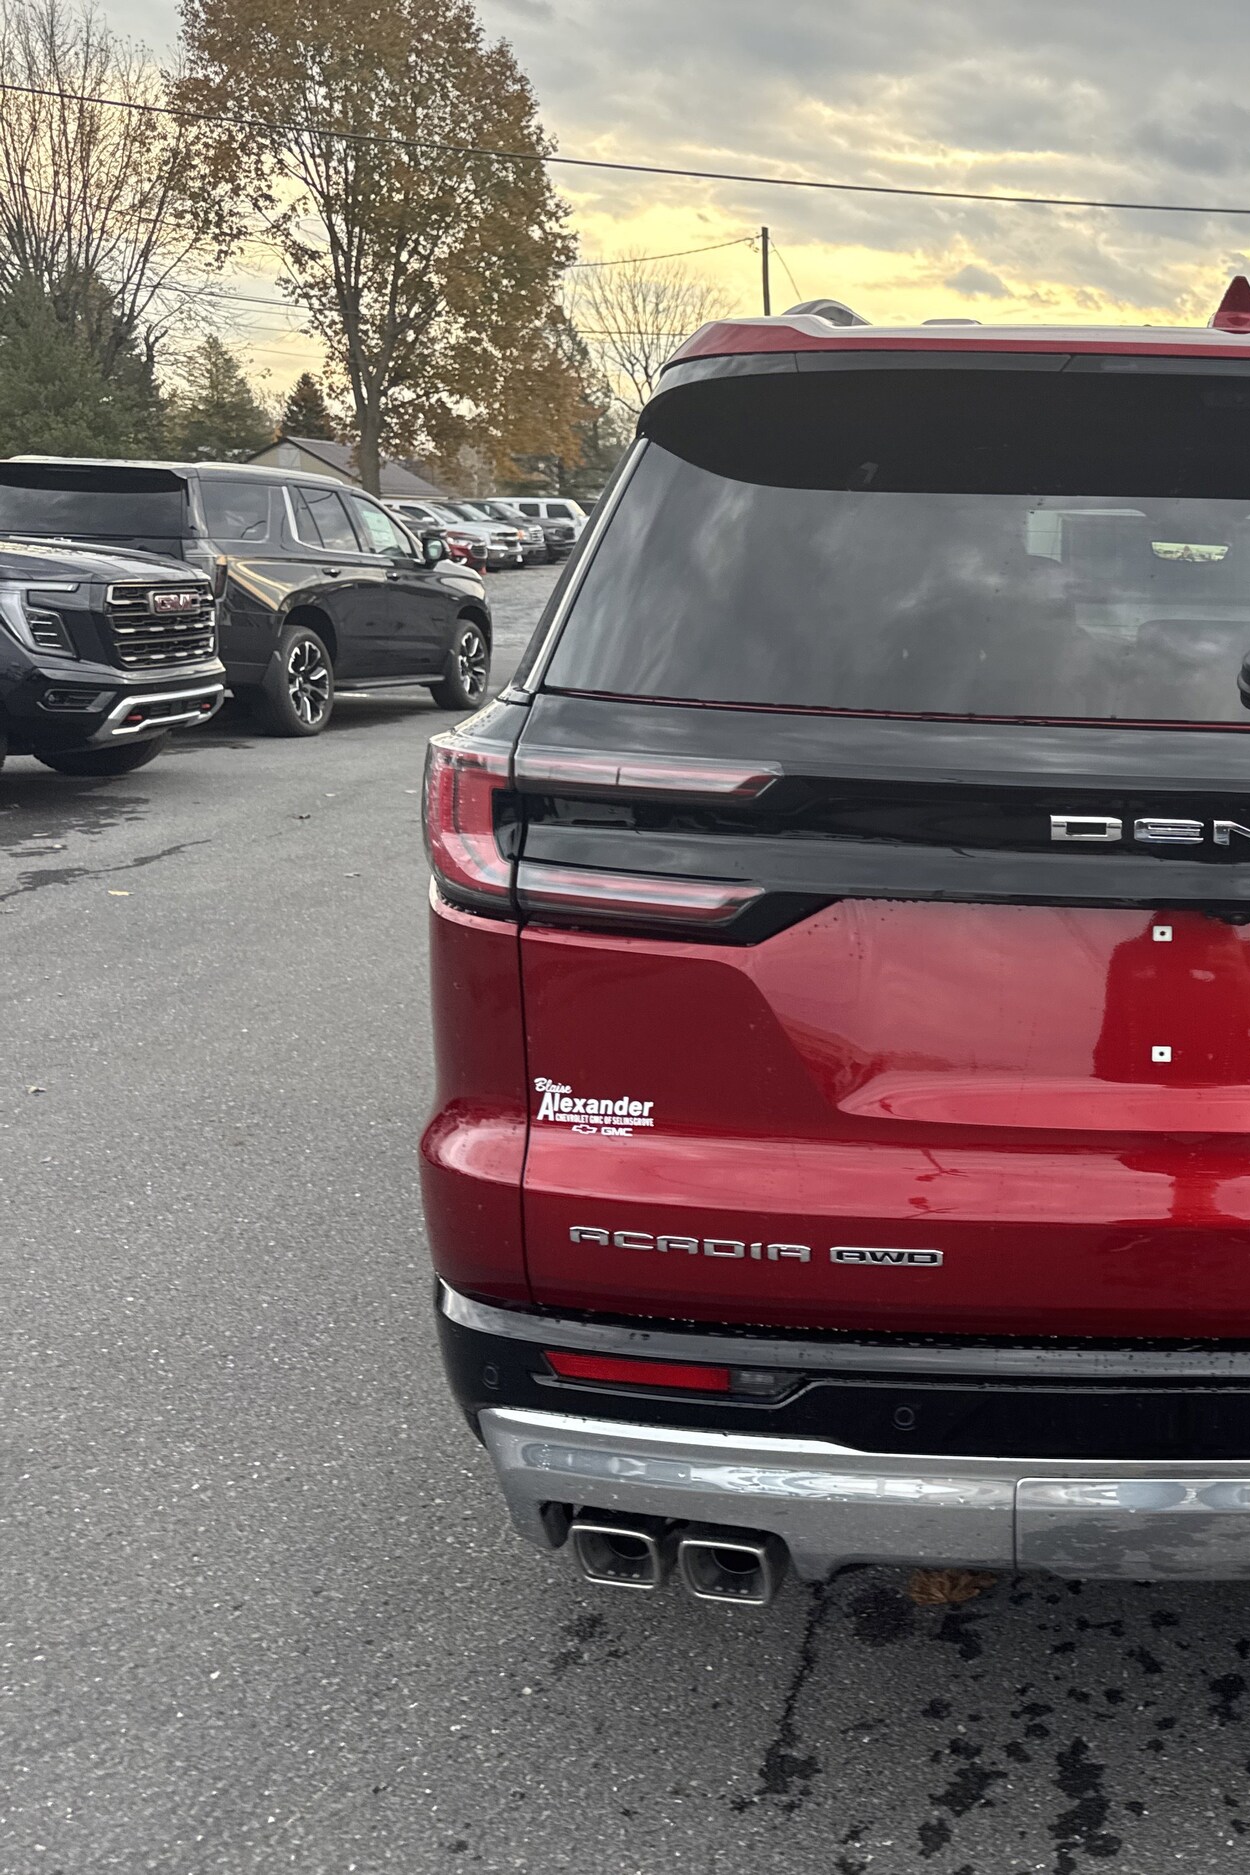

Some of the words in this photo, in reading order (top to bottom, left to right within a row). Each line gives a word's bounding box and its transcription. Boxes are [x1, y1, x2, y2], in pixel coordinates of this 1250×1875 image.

[534, 1077, 572, 1094] Blaise
[536, 1092, 654, 1121] Alexander
[555, 1113, 588, 1123] CHEVROLET
[604, 1116, 613, 1125] OF
[601, 1126, 633, 1136] GMC
[569, 1225, 812, 1263] ACADIA
[832, 1247, 943, 1267] AWD
